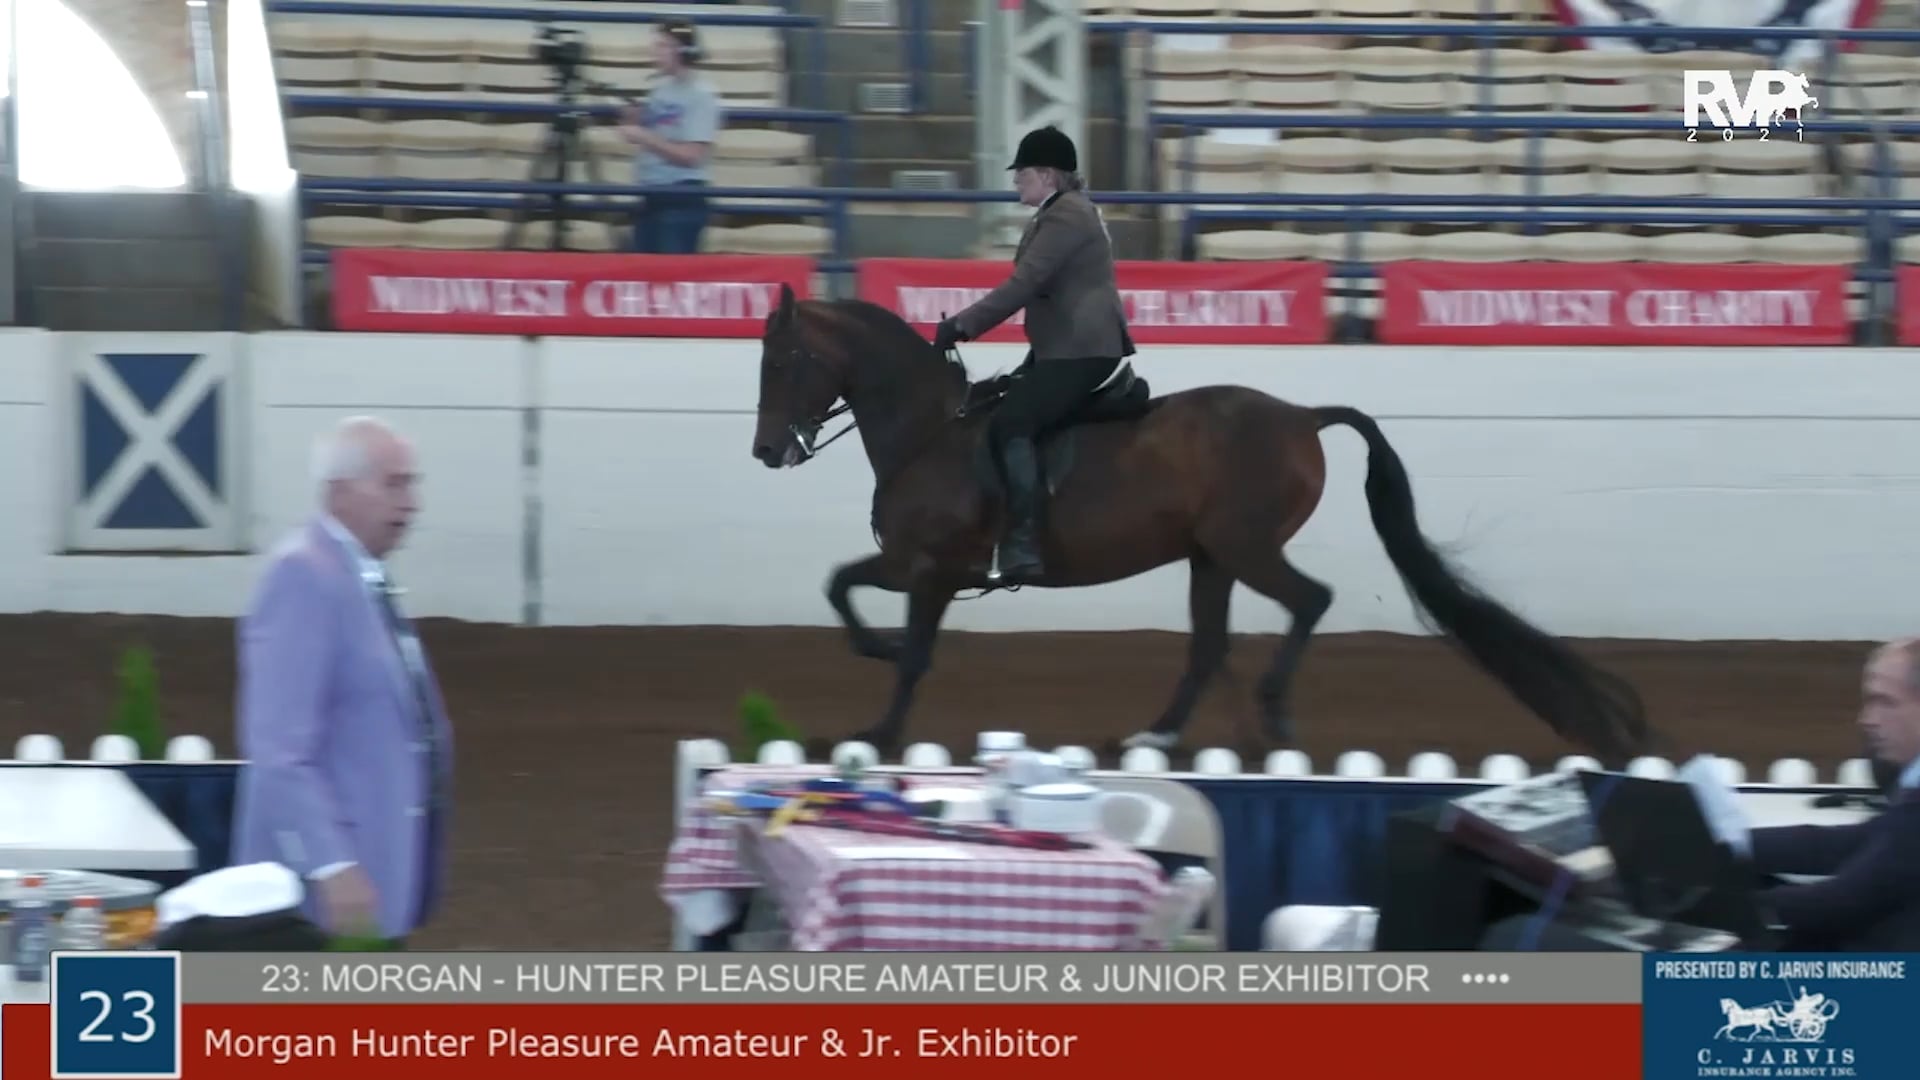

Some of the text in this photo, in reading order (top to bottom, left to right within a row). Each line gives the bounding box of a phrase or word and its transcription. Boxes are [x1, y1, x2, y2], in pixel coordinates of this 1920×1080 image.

[368, 276, 782, 318] MIDWEST CHARITY
[1417, 289, 1819, 326] MIDWEST CHARITY
